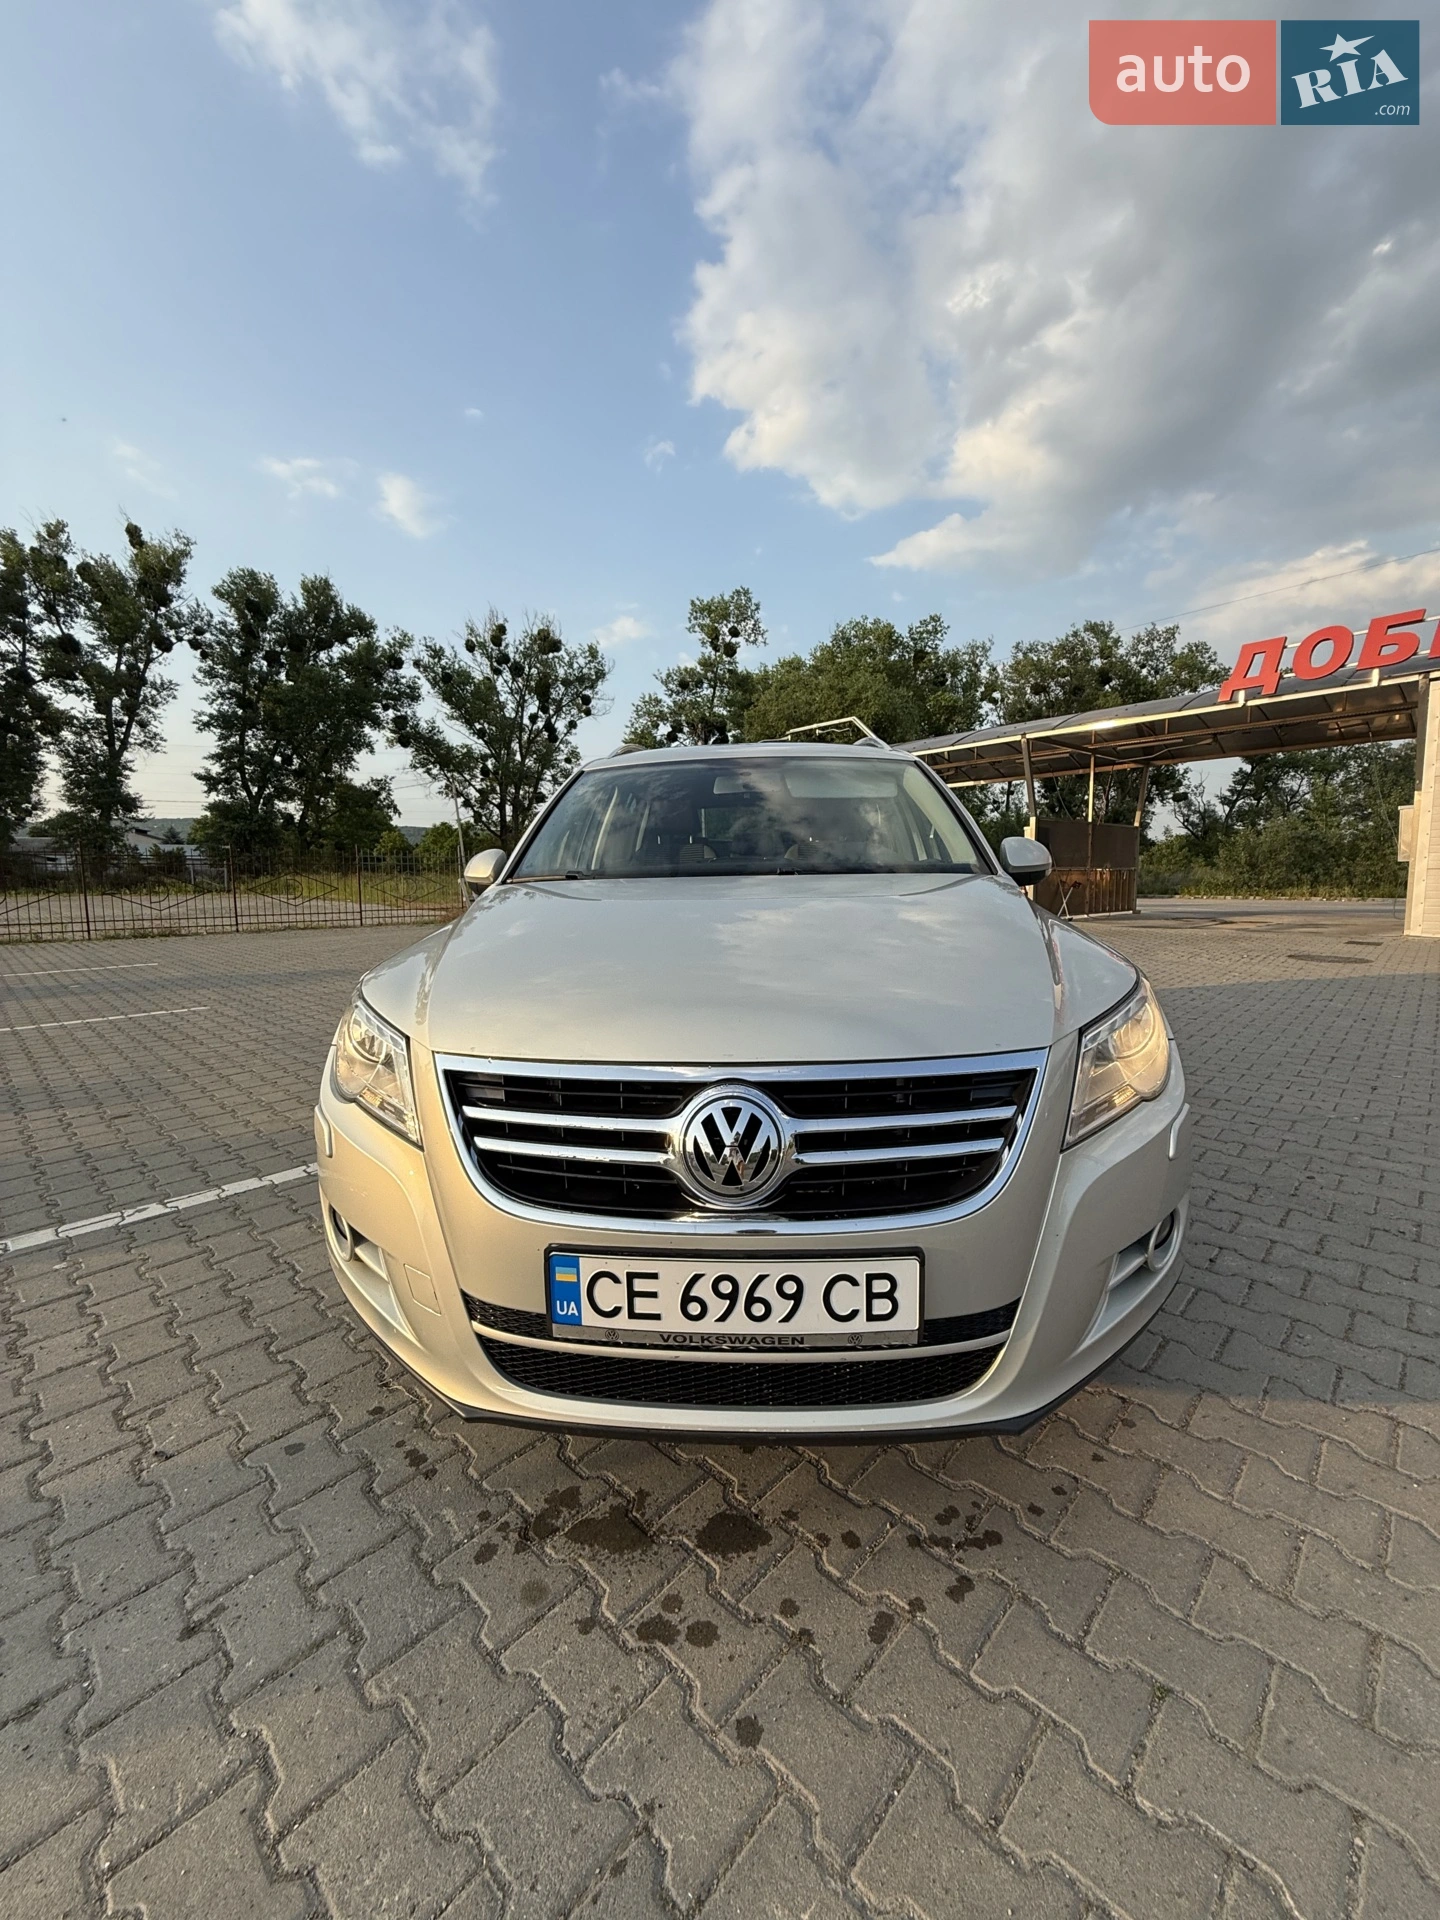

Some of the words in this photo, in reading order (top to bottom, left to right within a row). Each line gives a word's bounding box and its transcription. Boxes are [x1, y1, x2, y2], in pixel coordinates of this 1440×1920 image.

[586, 1269, 662, 1321] CE
[679, 1271, 805, 1323] 6969
[822, 1271, 899, 1323] CB
[556, 1301, 579, 1317] UA
[659, 1333, 805, 1346] VOLKSWAGEN
